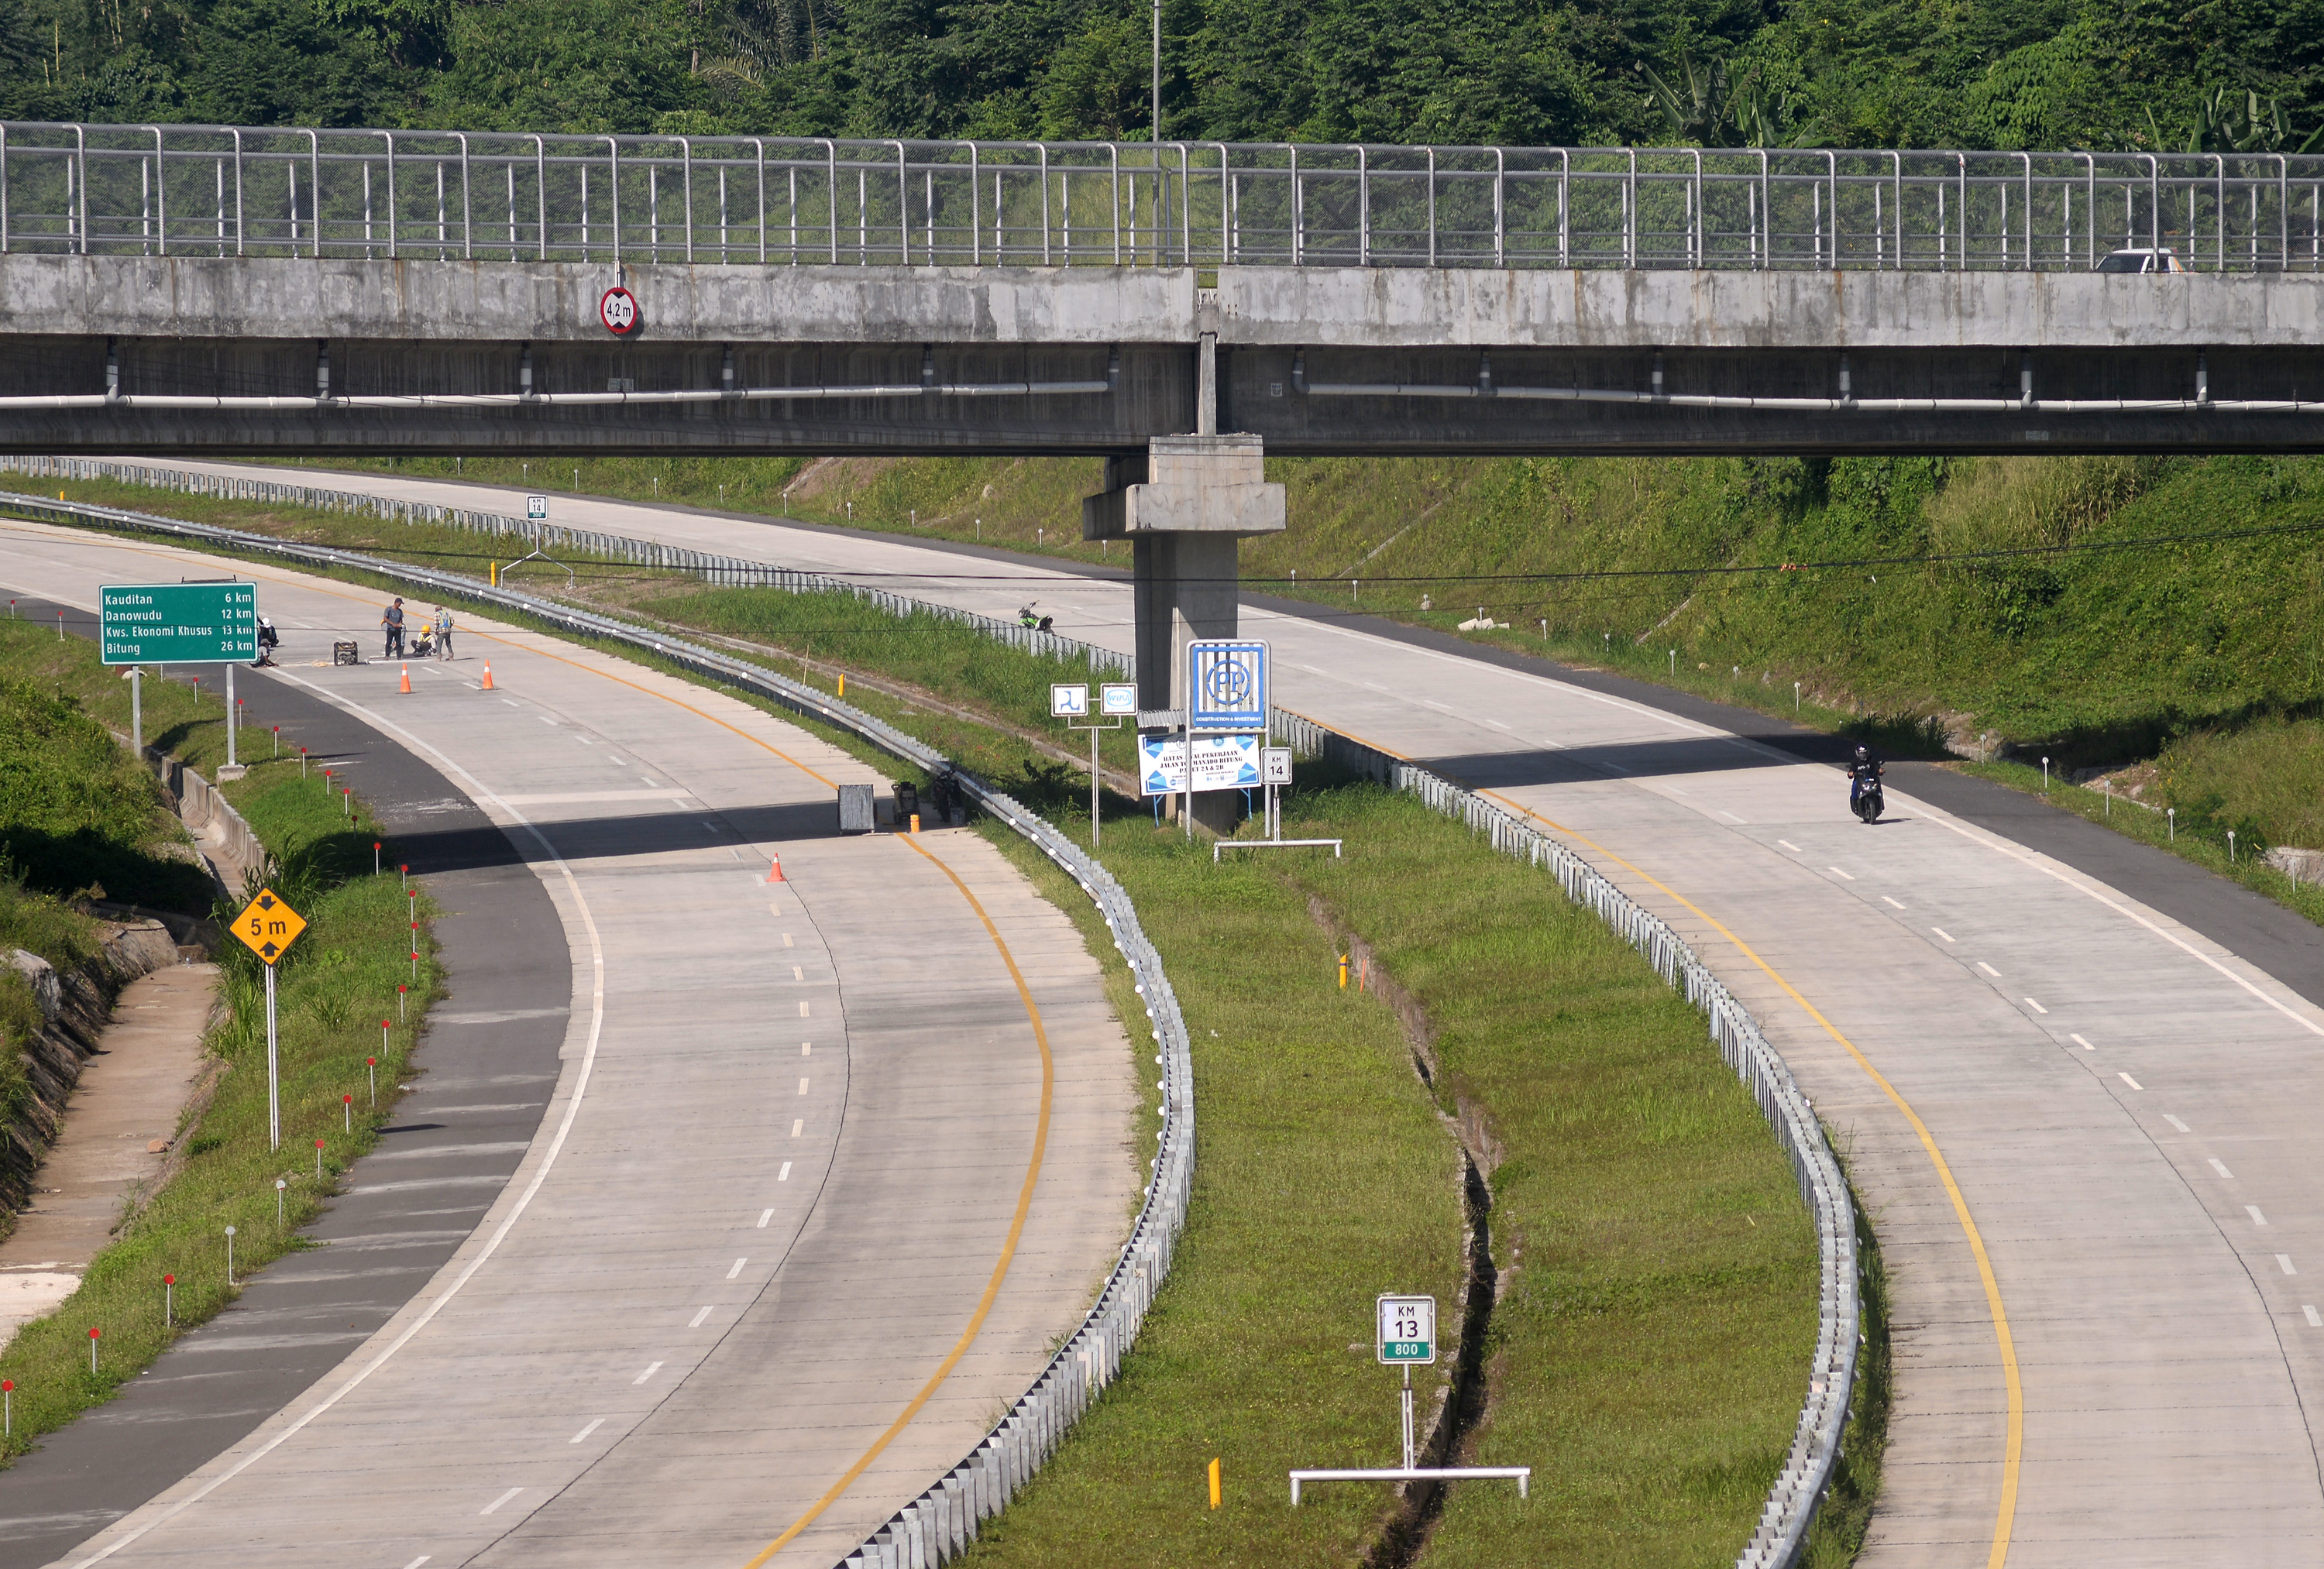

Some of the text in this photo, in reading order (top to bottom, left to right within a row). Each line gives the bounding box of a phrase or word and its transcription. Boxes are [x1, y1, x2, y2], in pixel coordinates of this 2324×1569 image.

[607, 302, 631, 318] 4,2 m
[105, 592, 251, 606] Kauditan 6 km
[105, 609, 252, 621] Danowudu 12 km
[106, 625, 253, 637] Kws. Ekonomi Khusus 13 km
[106, 640, 253, 655] Bitung 26 km
[1215, 671, 1245, 692] PP
[1202, 750, 1239, 758] PEKERJAAN
[1219, 756, 1243, 764] BITUNG
[1270, 765, 1284, 776] 14
[251, 918, 287, 936] 5 m
[1398, 1306, 1415, 1317] KM
[1395, 1320, 1418, 1338] 13
[1395, 1344, 1418, 1355] 800
